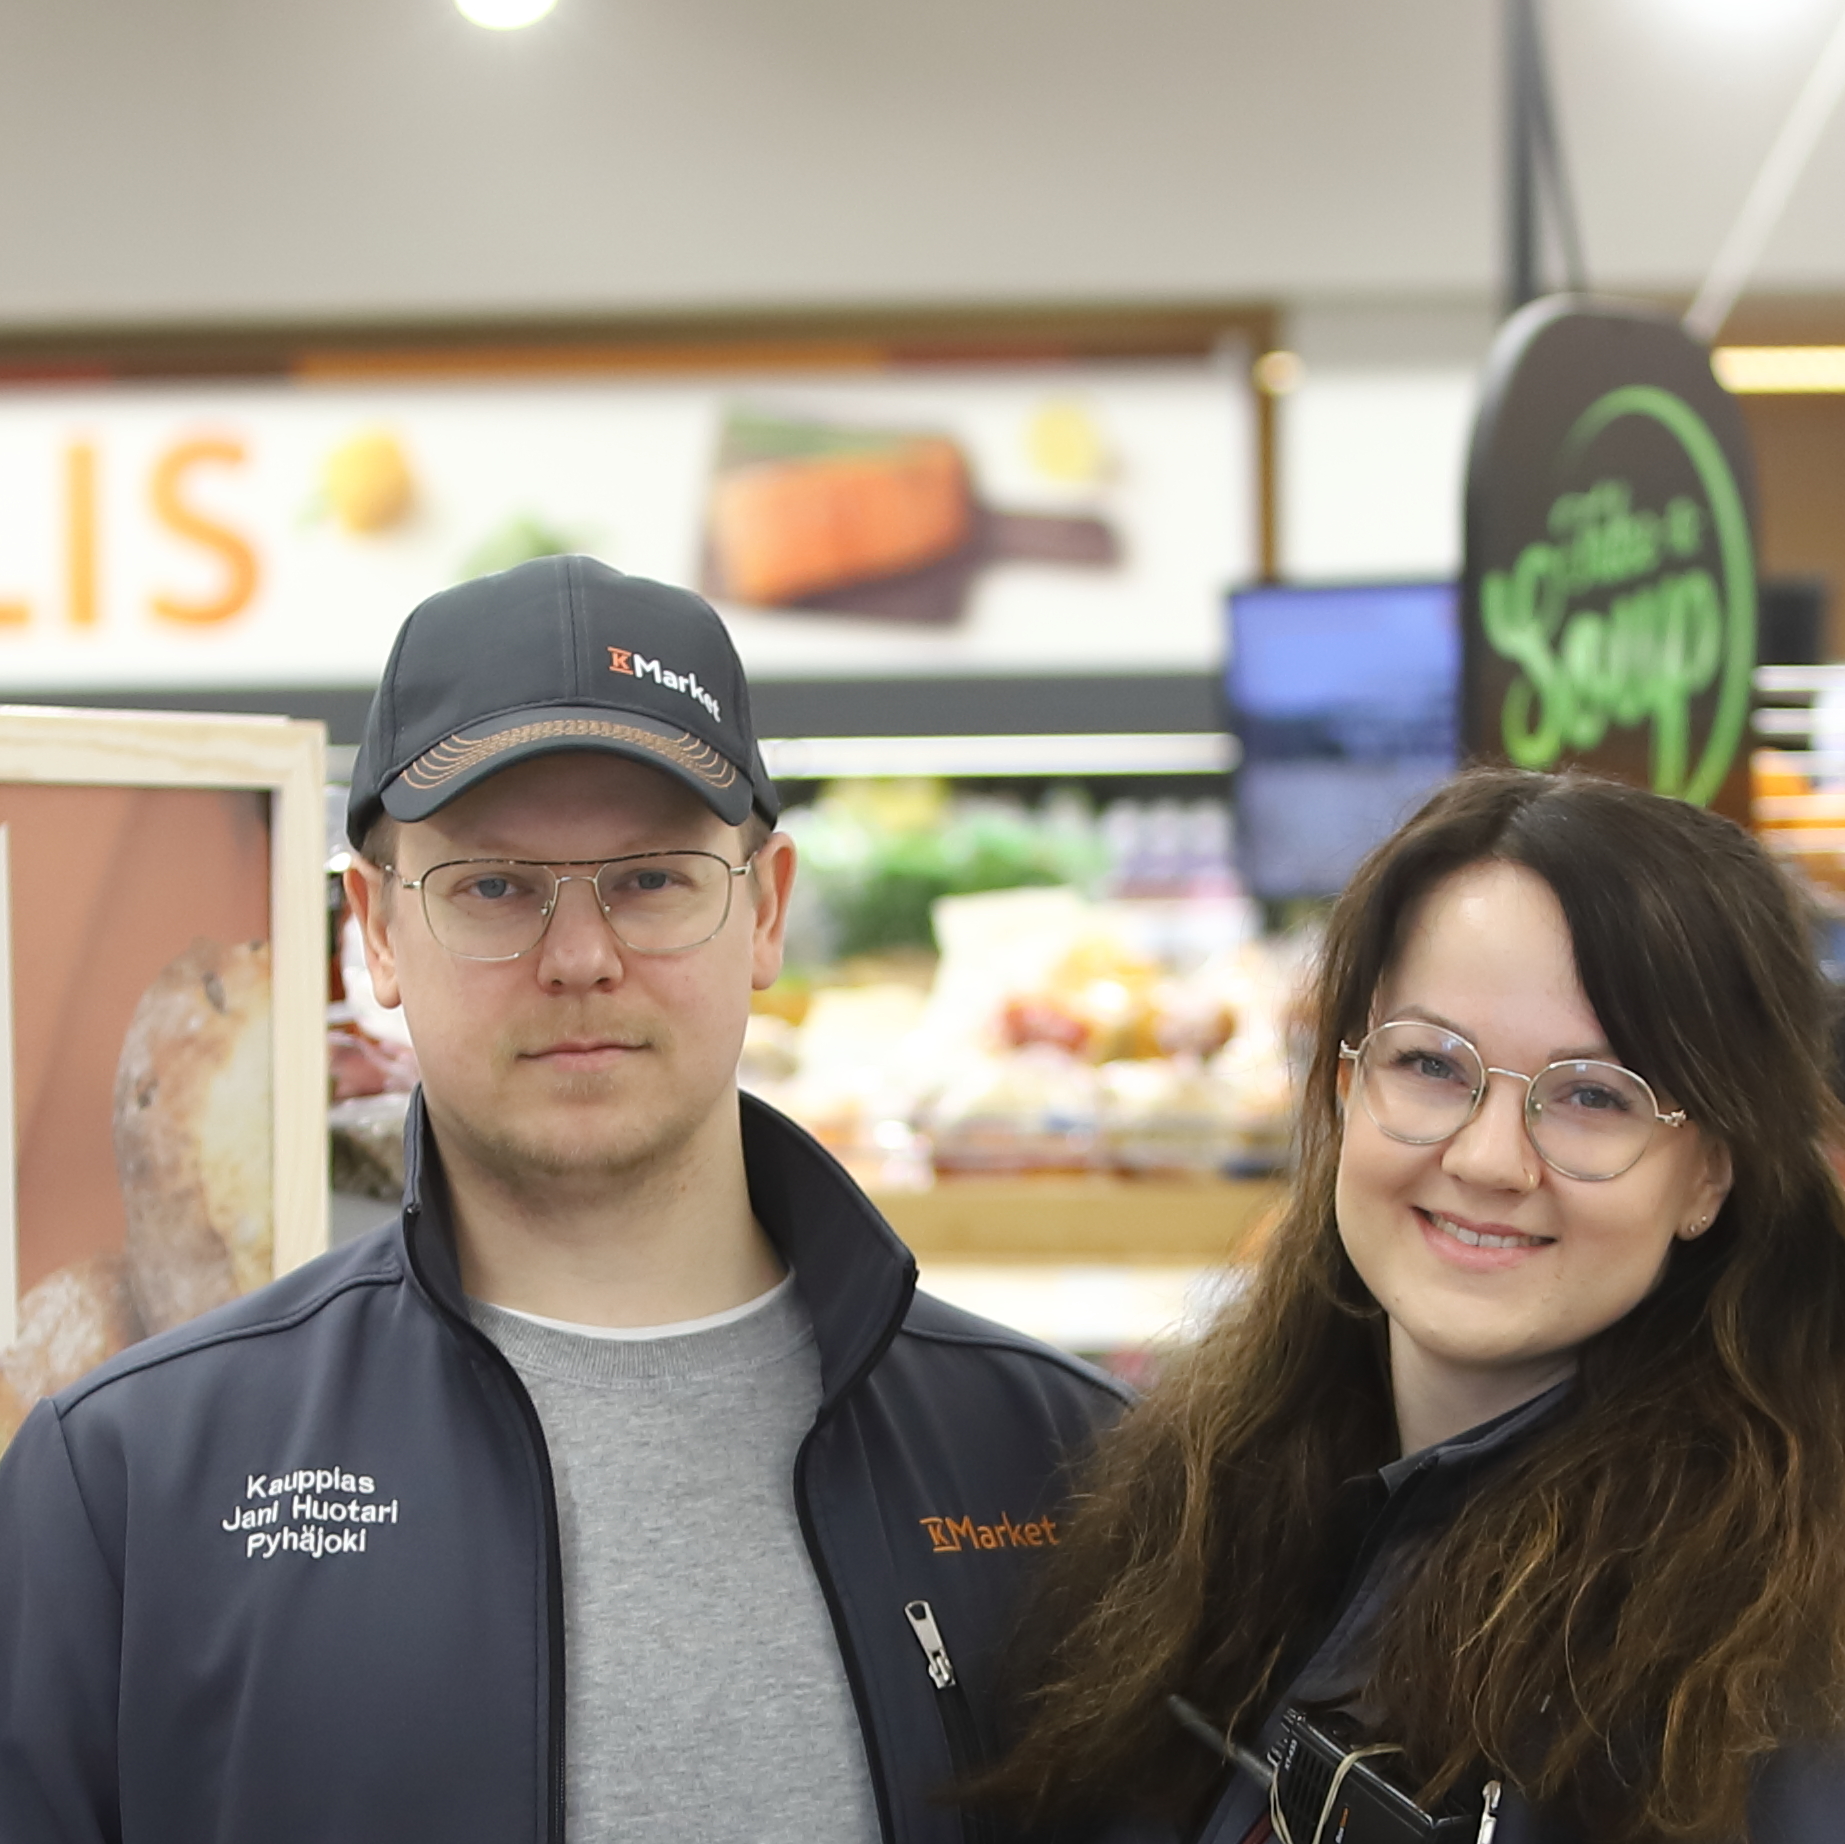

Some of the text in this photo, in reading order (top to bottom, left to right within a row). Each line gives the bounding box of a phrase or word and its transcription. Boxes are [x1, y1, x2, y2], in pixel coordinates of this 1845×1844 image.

[246, 1465, 376, 1500] Kauppias
[221, 1493, 399, 1532] Jani Huotari
[246, 1523, 367, 1560] Pyhäjoki
